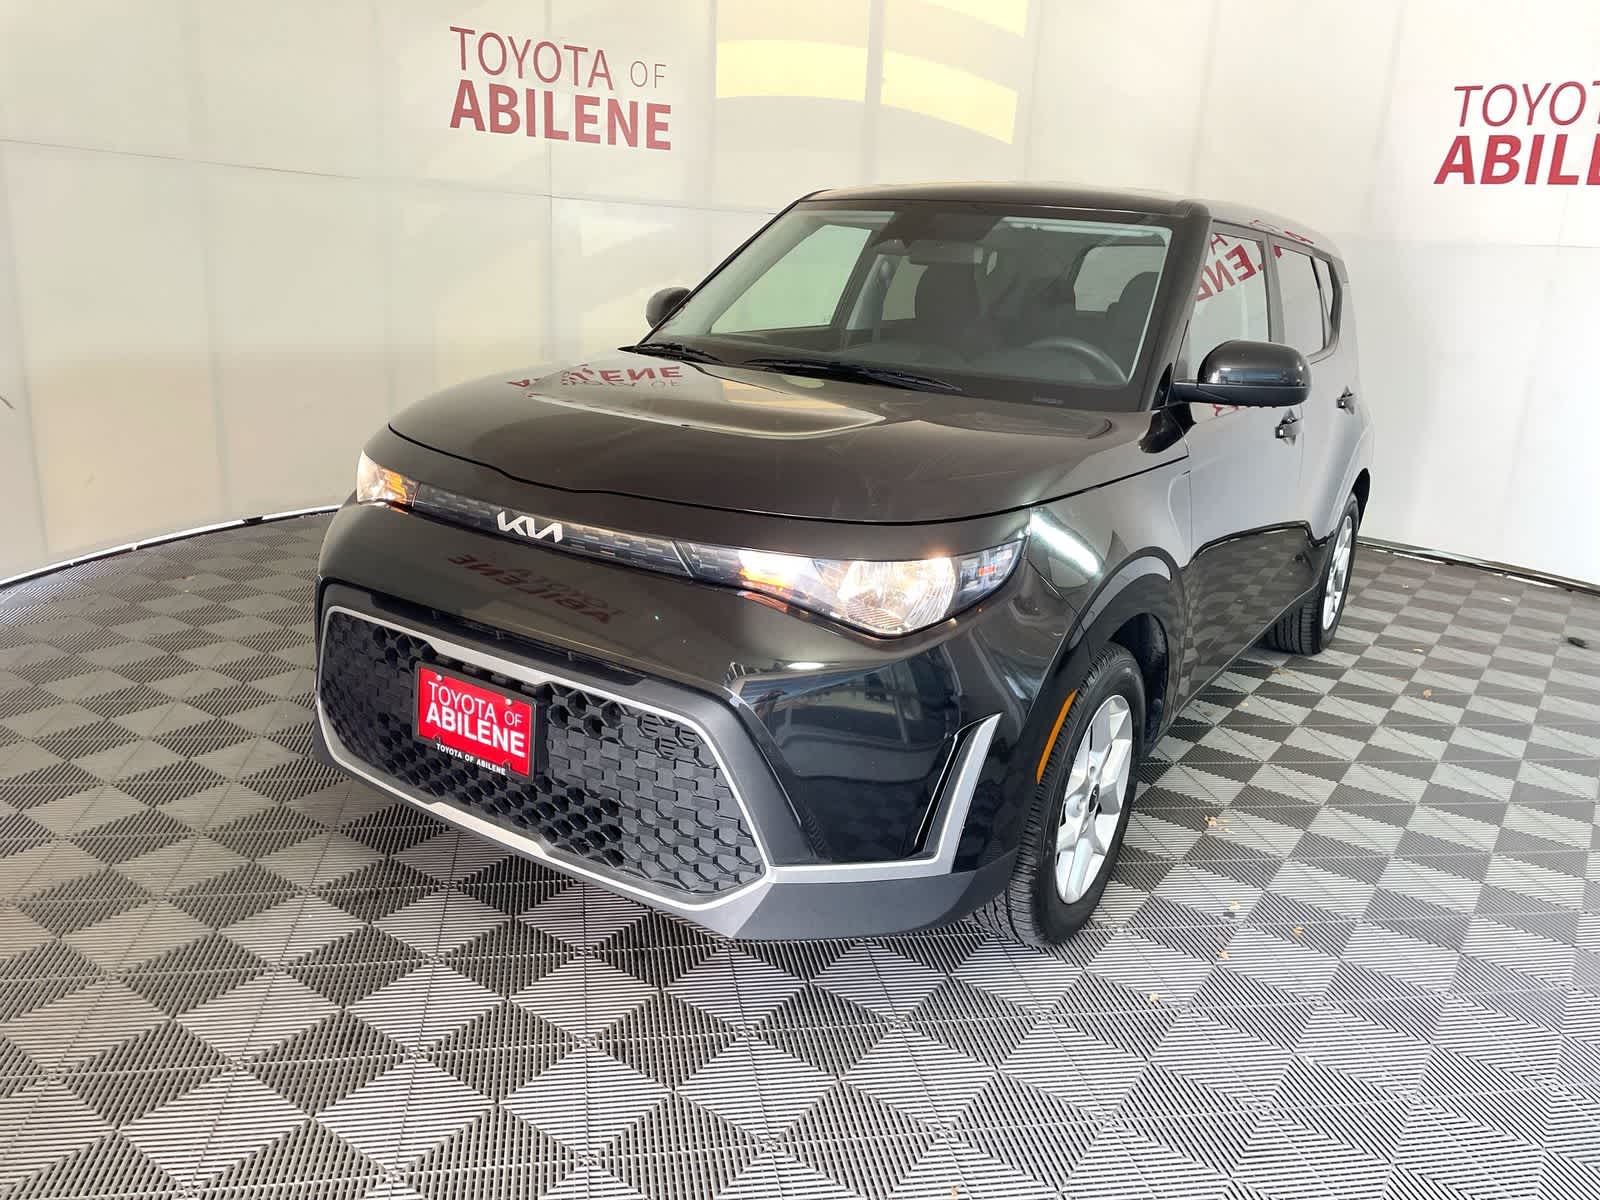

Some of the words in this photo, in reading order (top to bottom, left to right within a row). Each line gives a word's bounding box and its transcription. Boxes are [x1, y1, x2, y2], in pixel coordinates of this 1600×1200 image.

[450, 26, 613, 90] TOYOTA
[630, 61, 666, 88] OF
[450, 79, 671, 151] ABILENE
[1454, 80, 1600, 127] TOYO
[497, 511, 563, 543] KIA
[428, 681, 497, 723] TOYOTA
[504, 710, 523, 727] OF
[426, 702, 526, 758] ABILENE
[436, 743, 463, 759] TOYOTA
[464, 754, 474, 763] OF
[476, 759, 506, 776] ABILENE
